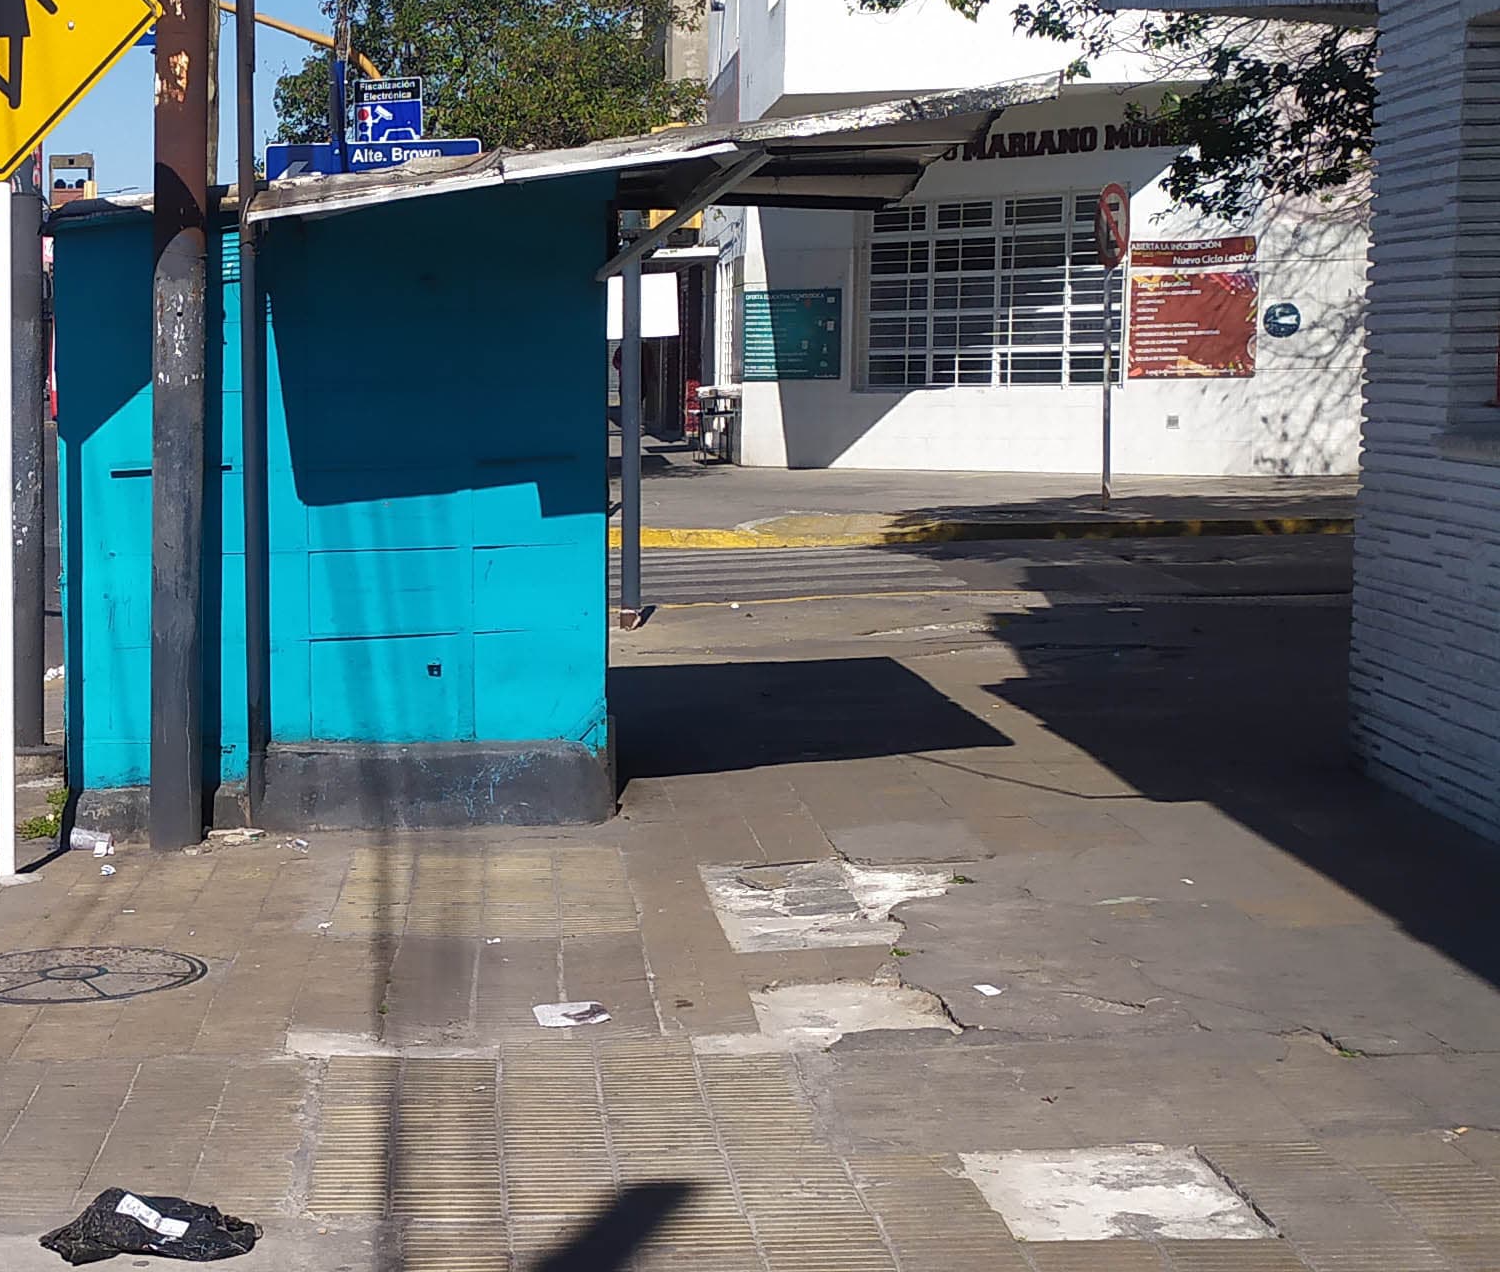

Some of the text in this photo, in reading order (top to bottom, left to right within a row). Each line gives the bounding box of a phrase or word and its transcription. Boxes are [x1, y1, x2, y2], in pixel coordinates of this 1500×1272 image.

[359, 81, 416, 90] Fiscalización
[363, 91, 412, 101] Electrónica
[963, 127, 1098, 161] MARIANO
[352, 147, 442, 163] Alte. Brown
[1173, 252, 1256, 265] Nuevo Ciclo Lectivo
